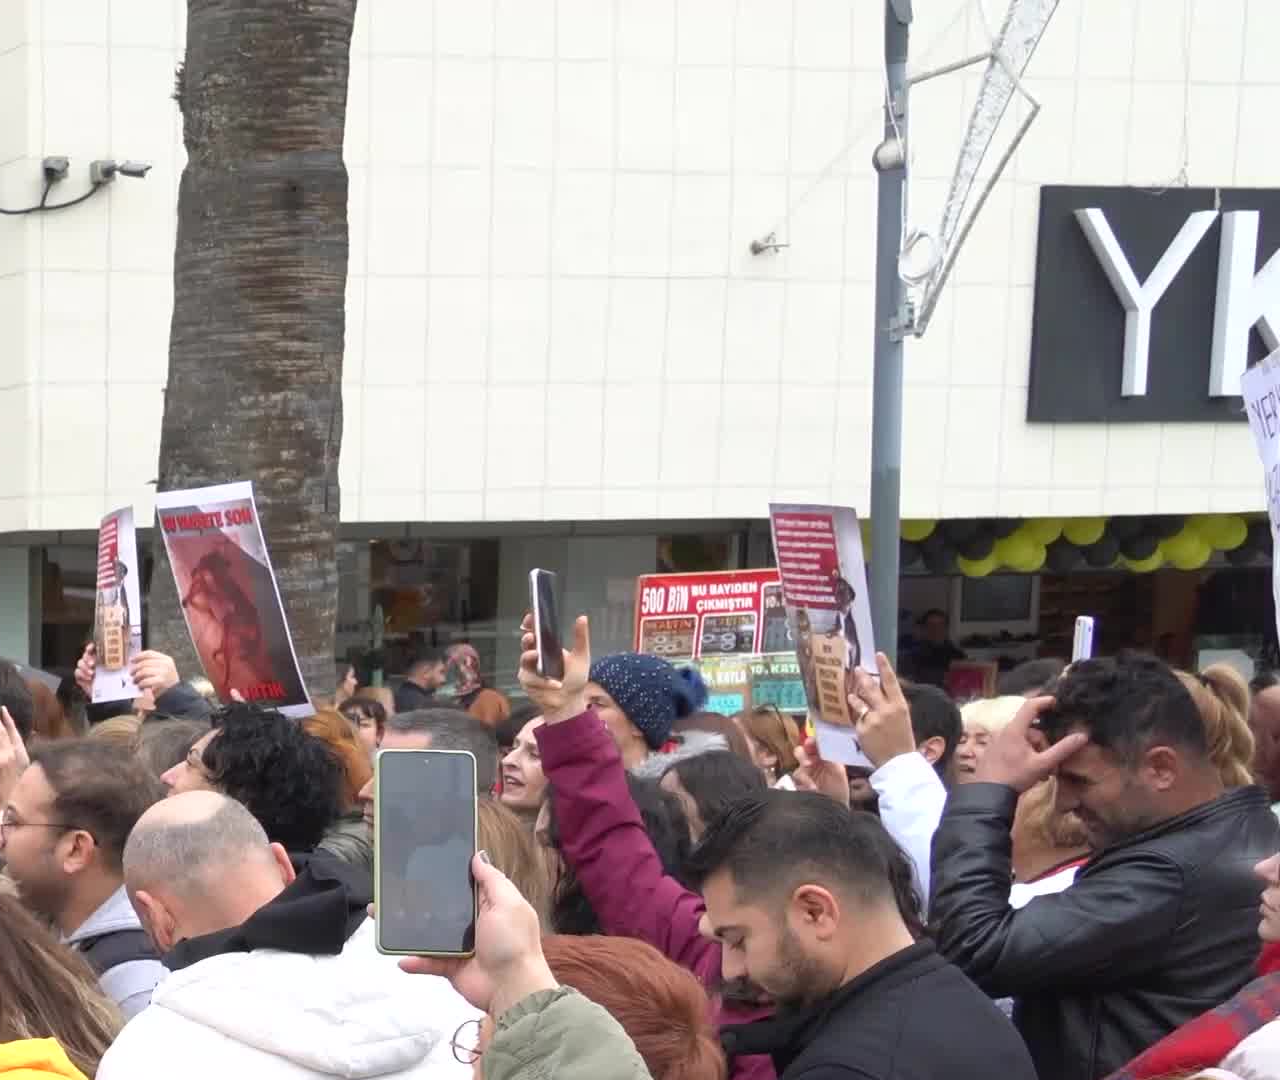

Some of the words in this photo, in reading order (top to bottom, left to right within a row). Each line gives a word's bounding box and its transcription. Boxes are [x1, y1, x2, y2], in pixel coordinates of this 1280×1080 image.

[225, 508, 252, 527] SON
[691, 584, 707, 597] BU
[642, 586, 665, 614] 500
[696, 597, 754, 614] ÇIKMIŞTIR
